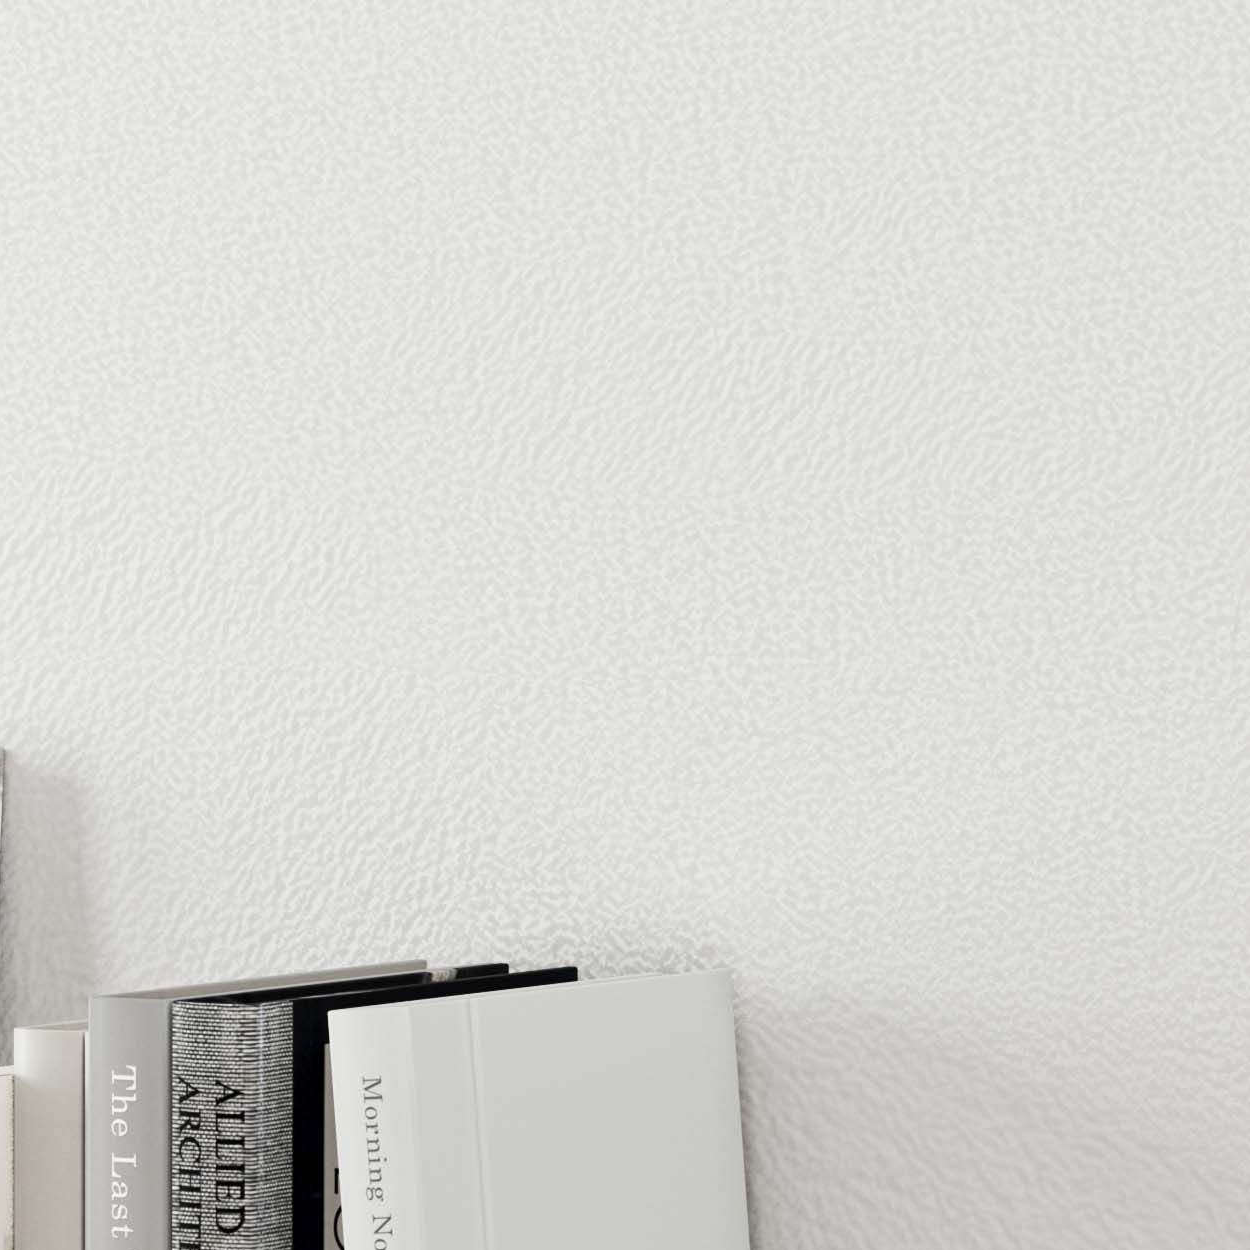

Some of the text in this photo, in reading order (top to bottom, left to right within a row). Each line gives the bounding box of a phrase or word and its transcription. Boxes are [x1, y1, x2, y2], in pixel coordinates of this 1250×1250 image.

[110, 1064, 137, 1137] The
[361, 1074, 388, 1204] Morning
[110, 1152, 137, 1239] Last
[215, 1079, 245, 1234] ALLIED
